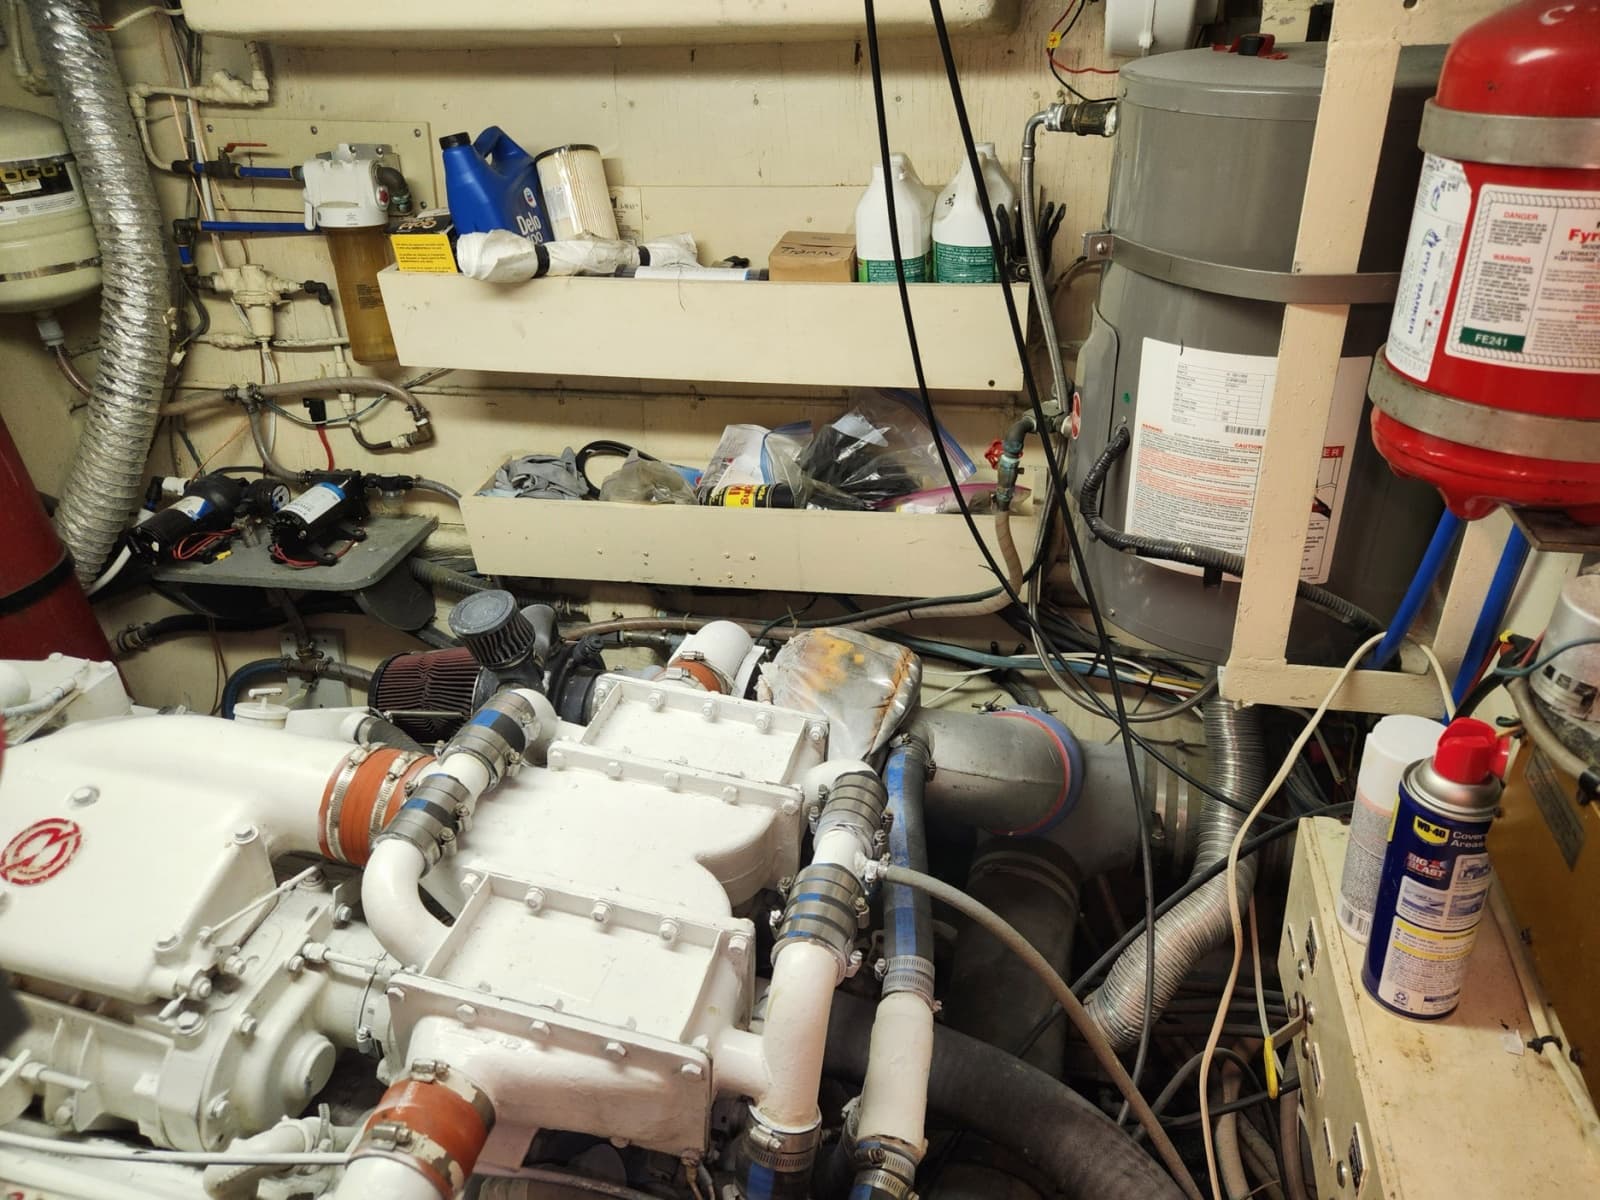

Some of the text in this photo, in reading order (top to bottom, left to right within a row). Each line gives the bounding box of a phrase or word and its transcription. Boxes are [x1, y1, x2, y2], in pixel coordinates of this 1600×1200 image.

[516, 211, 542, 236] Delo
[1474, 333, 1509, 347] FE241
[1416, 819, 1446, 838] WD-40
[1408, 852, 1429, 866] BIG
[1406, 860, 1447, 879] BLAST
